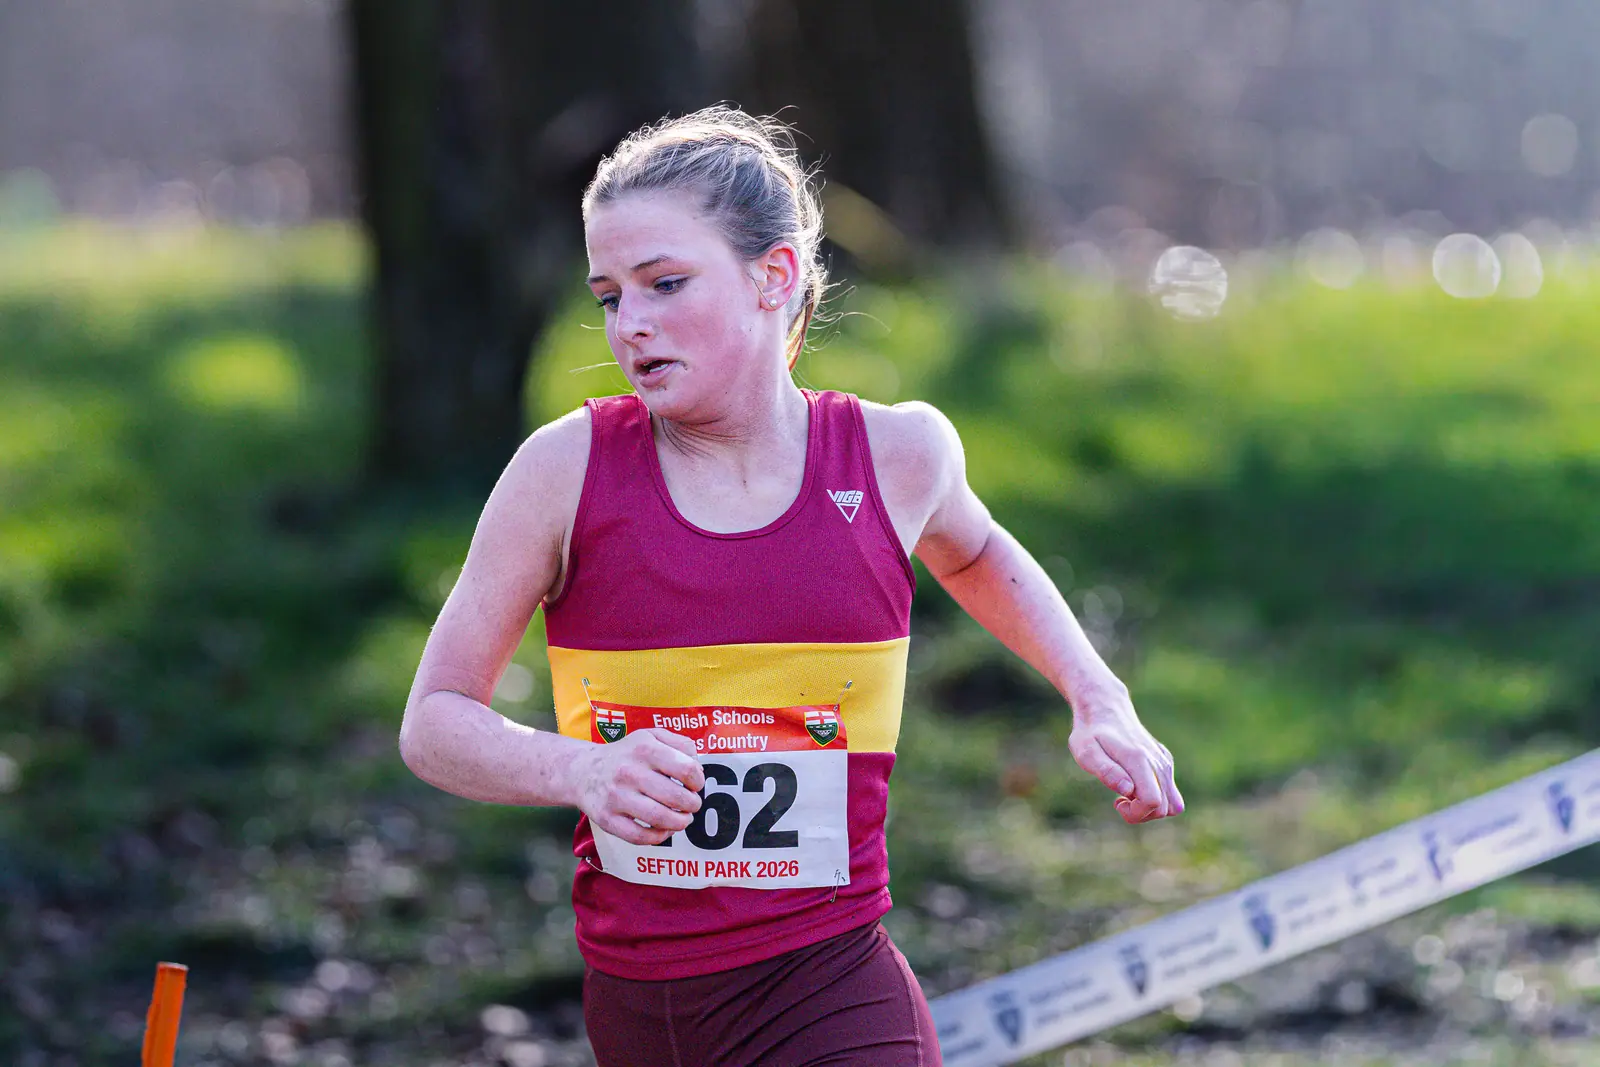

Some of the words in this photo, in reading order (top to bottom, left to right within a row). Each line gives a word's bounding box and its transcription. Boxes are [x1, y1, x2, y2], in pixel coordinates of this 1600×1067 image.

[652, 713, 709, 731] English
[712, 709, 775, 726] Schools
[707, 733, 769, 751] Country
[651, 762, 799, 850] 62
[636, 856, 699, 877] SEFTON
[704, 861, 752, 878] PARK
[756, 860, 799, 878] 2026
